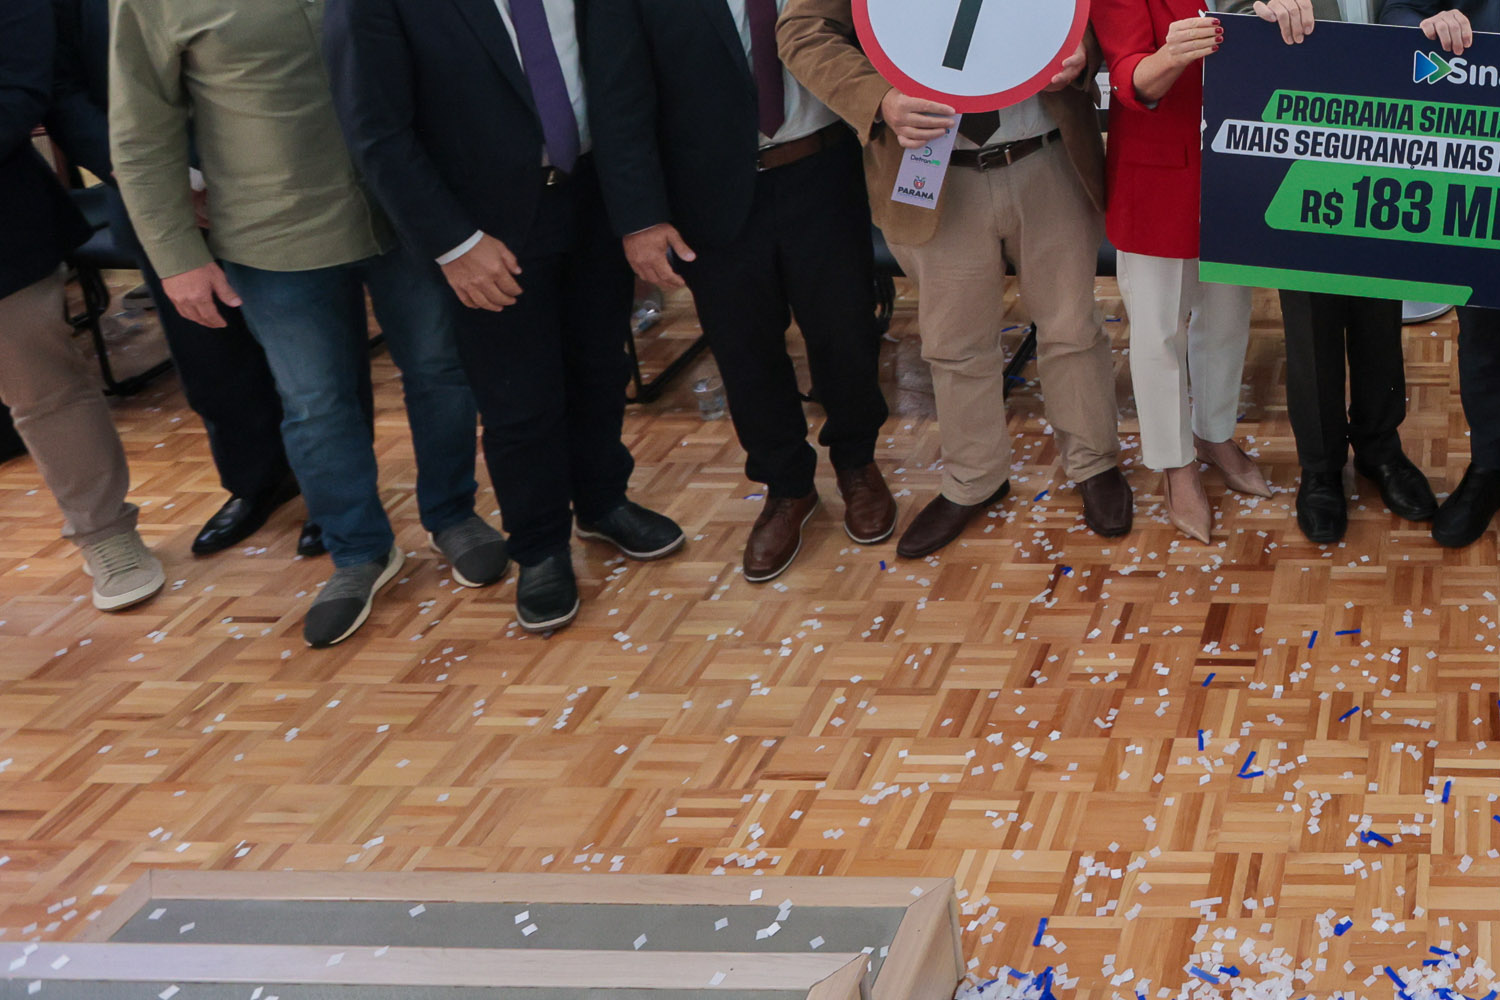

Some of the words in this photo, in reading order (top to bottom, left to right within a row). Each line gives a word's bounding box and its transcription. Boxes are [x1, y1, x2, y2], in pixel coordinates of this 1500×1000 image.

[1276, 93, 1414, 131] PROGRAMA
[1225, 123, 1289, 154] MAIS
[1294, 130, 1438, 169] SEGURANÇA
[1443, 143, 1494, 172] NAS
[1300, 188, 1344, 228] R$
[1352, 175, 1434, 234] 183
